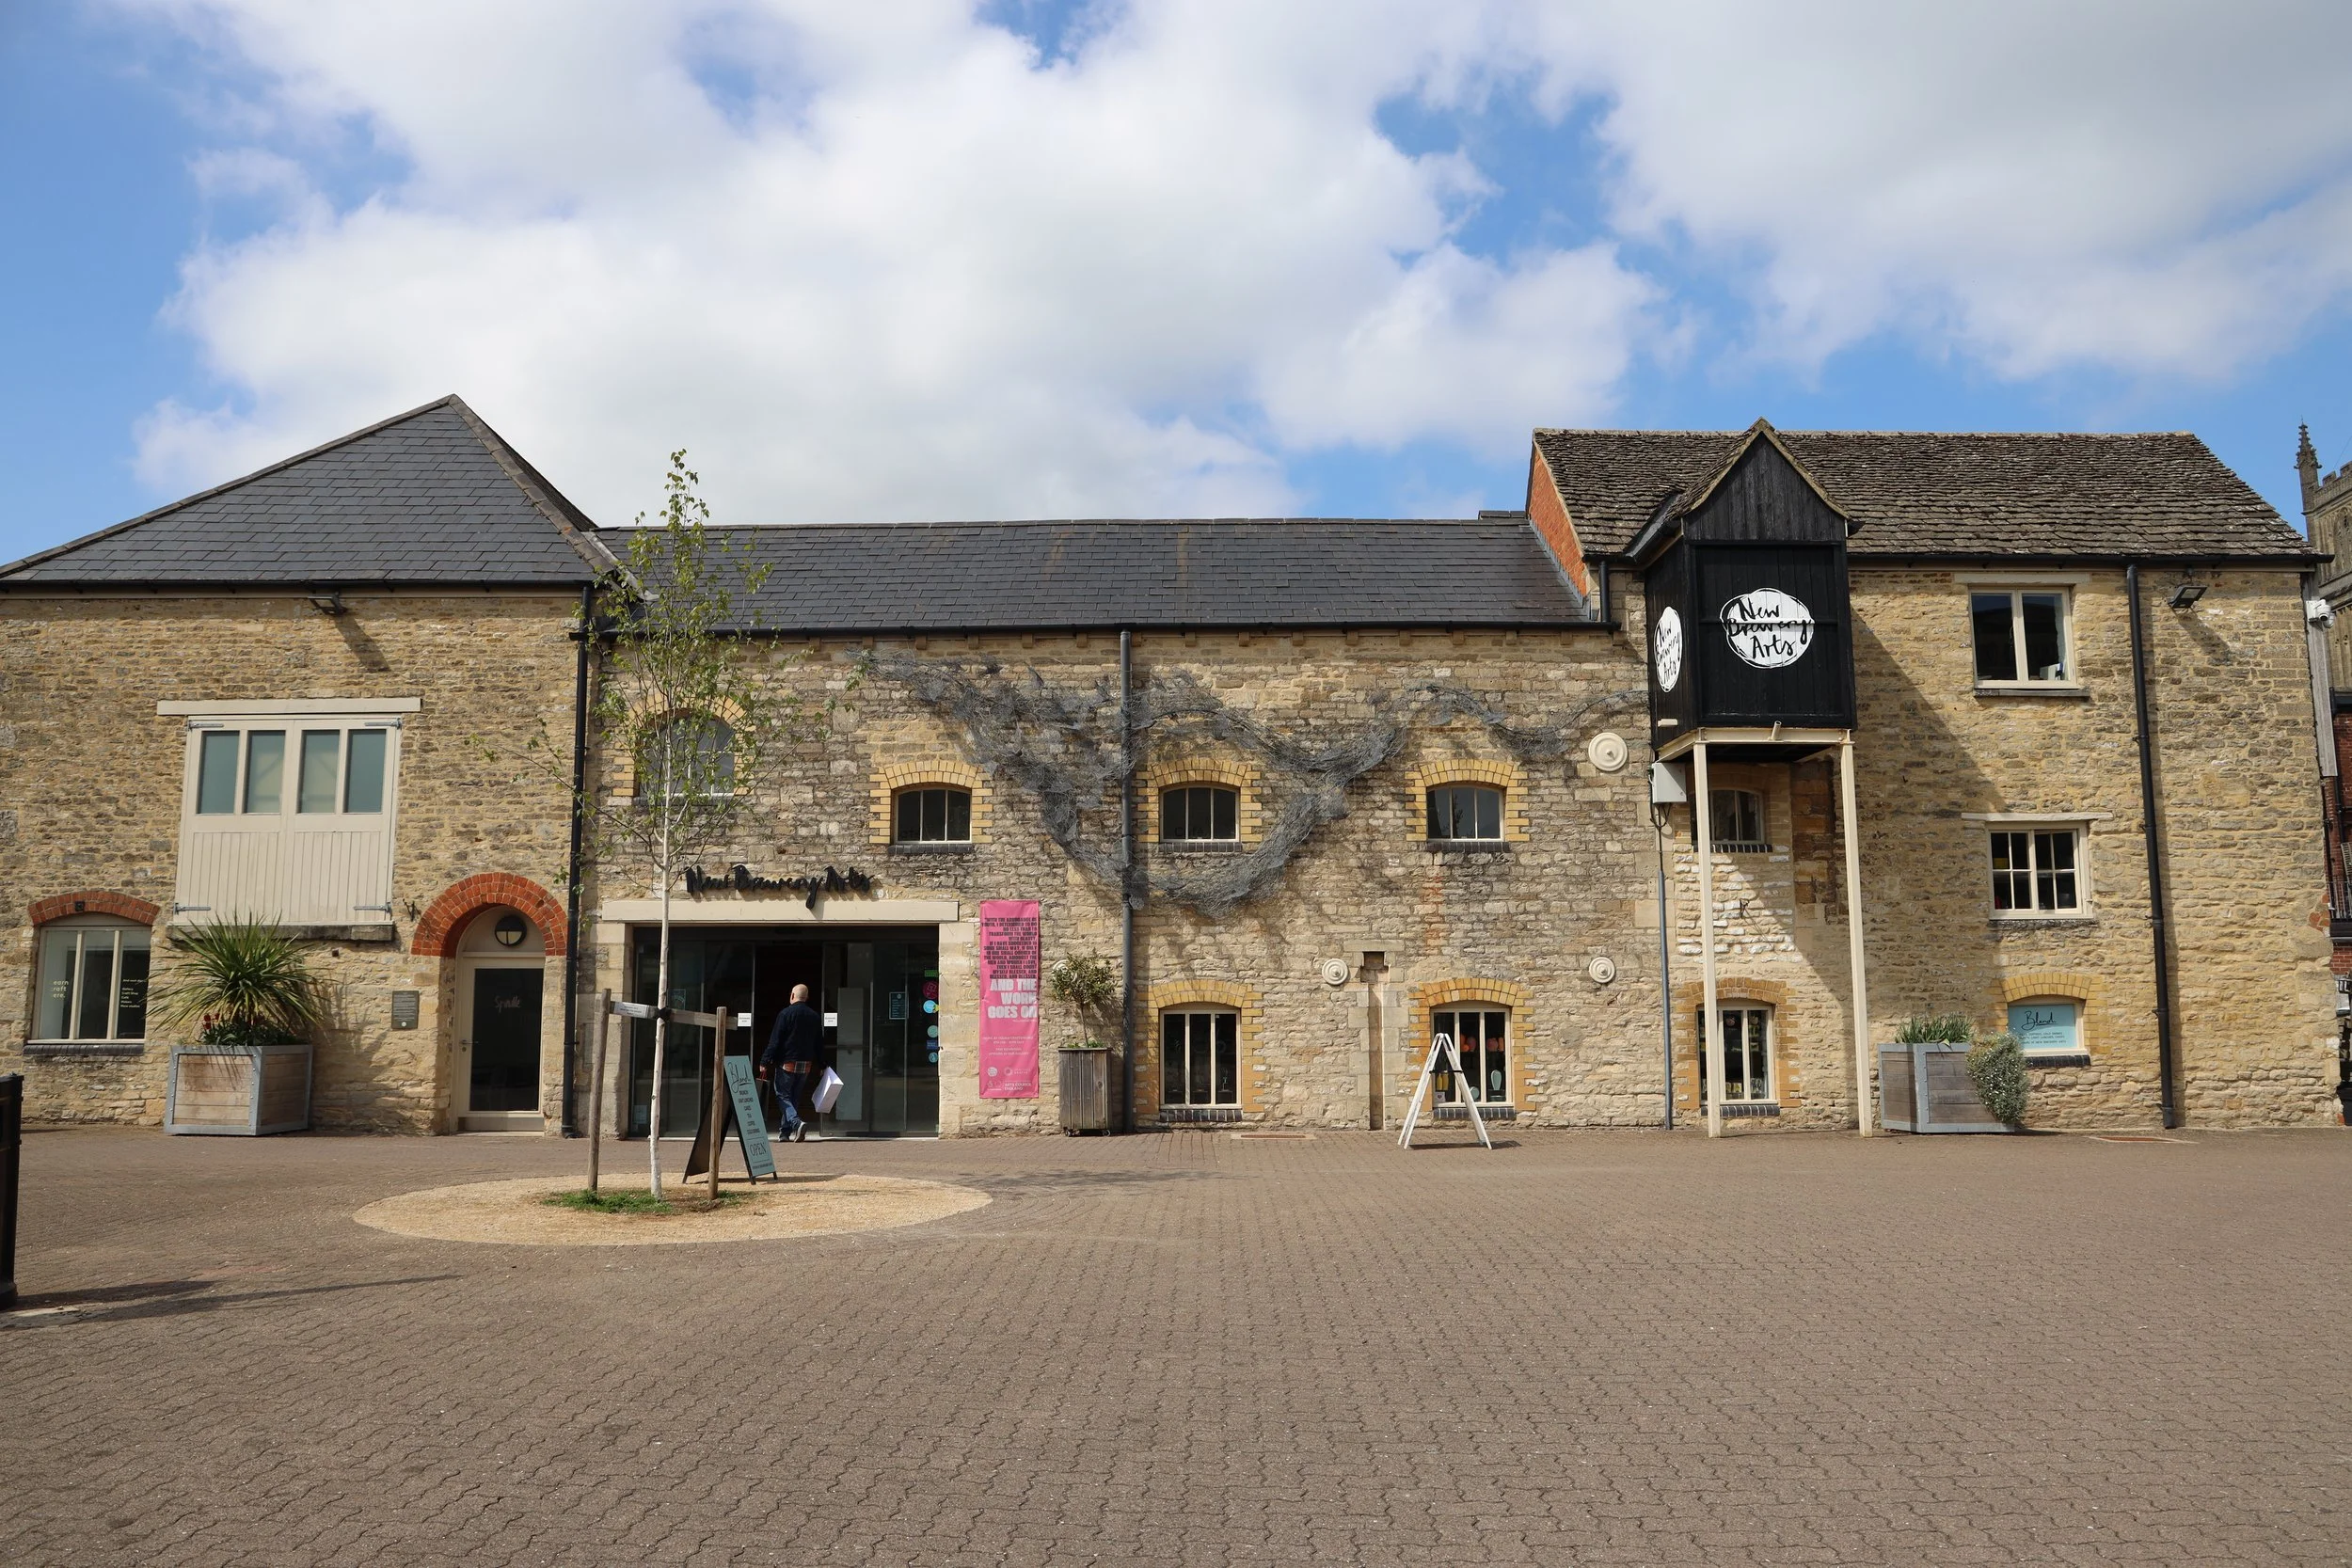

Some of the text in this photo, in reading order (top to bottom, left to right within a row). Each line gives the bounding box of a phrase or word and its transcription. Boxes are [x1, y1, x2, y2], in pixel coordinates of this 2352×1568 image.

[1739, 597, 1780, 621] New
[1658, 620, 1672, 647] New
[1727, 618, 1815, 644] Brewery
[1750, 634, 1796, 659] Arts
[684, 863, 875, 910] New Brewery Arts
[990, 979, 1037, 991] AND THE
[1001, 992, 1037, 1005] WORK
[988, 1006, 1037, 1018] GOES ON
[2021, 1011, 2058, 1030] Blend
[750, 1142, 766, 1156] OPEN
